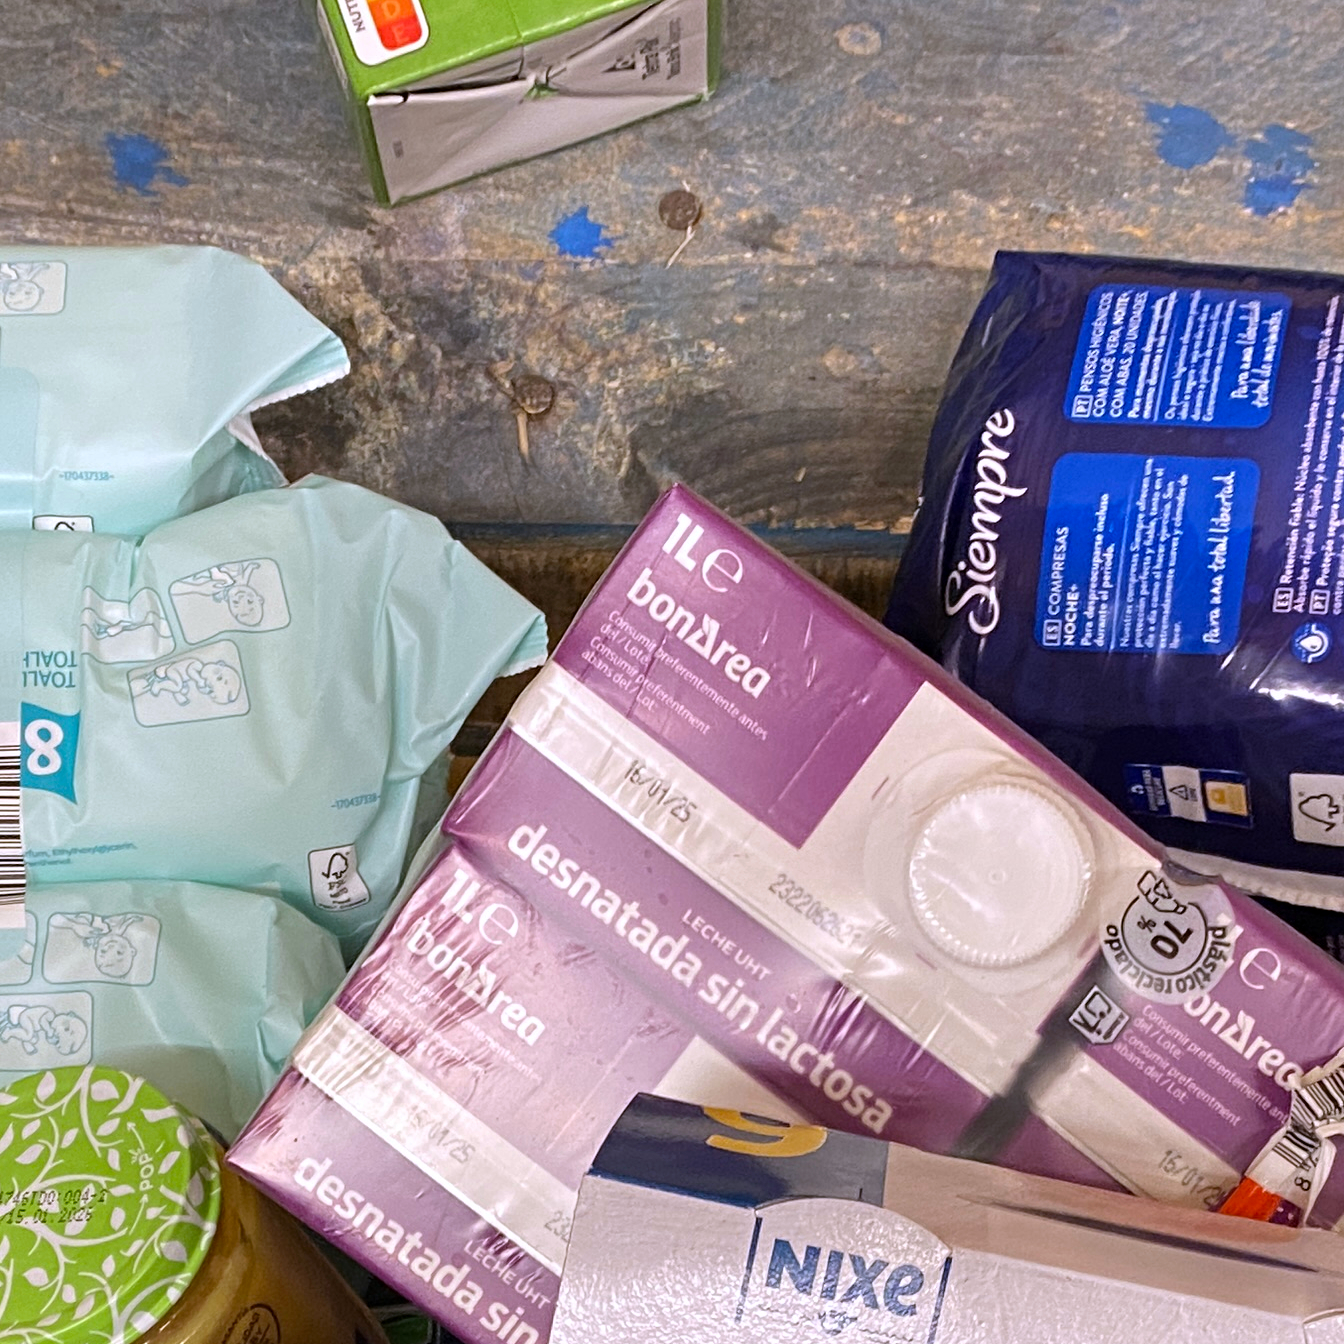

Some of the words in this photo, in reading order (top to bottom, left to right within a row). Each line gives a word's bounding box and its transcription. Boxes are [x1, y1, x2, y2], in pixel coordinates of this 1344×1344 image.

[1081, 351, 1103, 395] PENSOS
[662, 512, 706, 574] 1L
[945, 407, 1028, 636] Siempre
[1095, 493, 1109, 536] incluso
[1048, 526, 1070, 616] COMPRESAS
[1083, 537, 1106, 618] despreocuparse
[1209, 536, 1228, 572] total
[1045, 621, 1061, 646] ES
[1062, 582, 1078, 646] NOCHE+
[1080, 620, 1093, 646] Para
[1093, 605, 1106, 647] durante
[1202, 607, 1223, 645] Para
[623, 759, 699, 826] 16/01/25
[681, 907, 735, 952] LECHE
[732, 945, 773, 982] UHT
[1106, 923, 1174, 993] reciclado
[1150, 919, 1194, 960] 70
[1174, 923, 1228, 996] plástico
[507, 821, 703, 997] desnatada
[697, 963, 760, 1036] sin
[754, 1008, 895, 1137] lactosa
[1141, 1003, 1192, 1045] Consumir
[139, 1153, 156, 1191] POP
[292, 1153, 481, 1317] desnatada
[462, 1239, 518, 1286] LECHE
[516, 1275, 556, 1311] UHT
